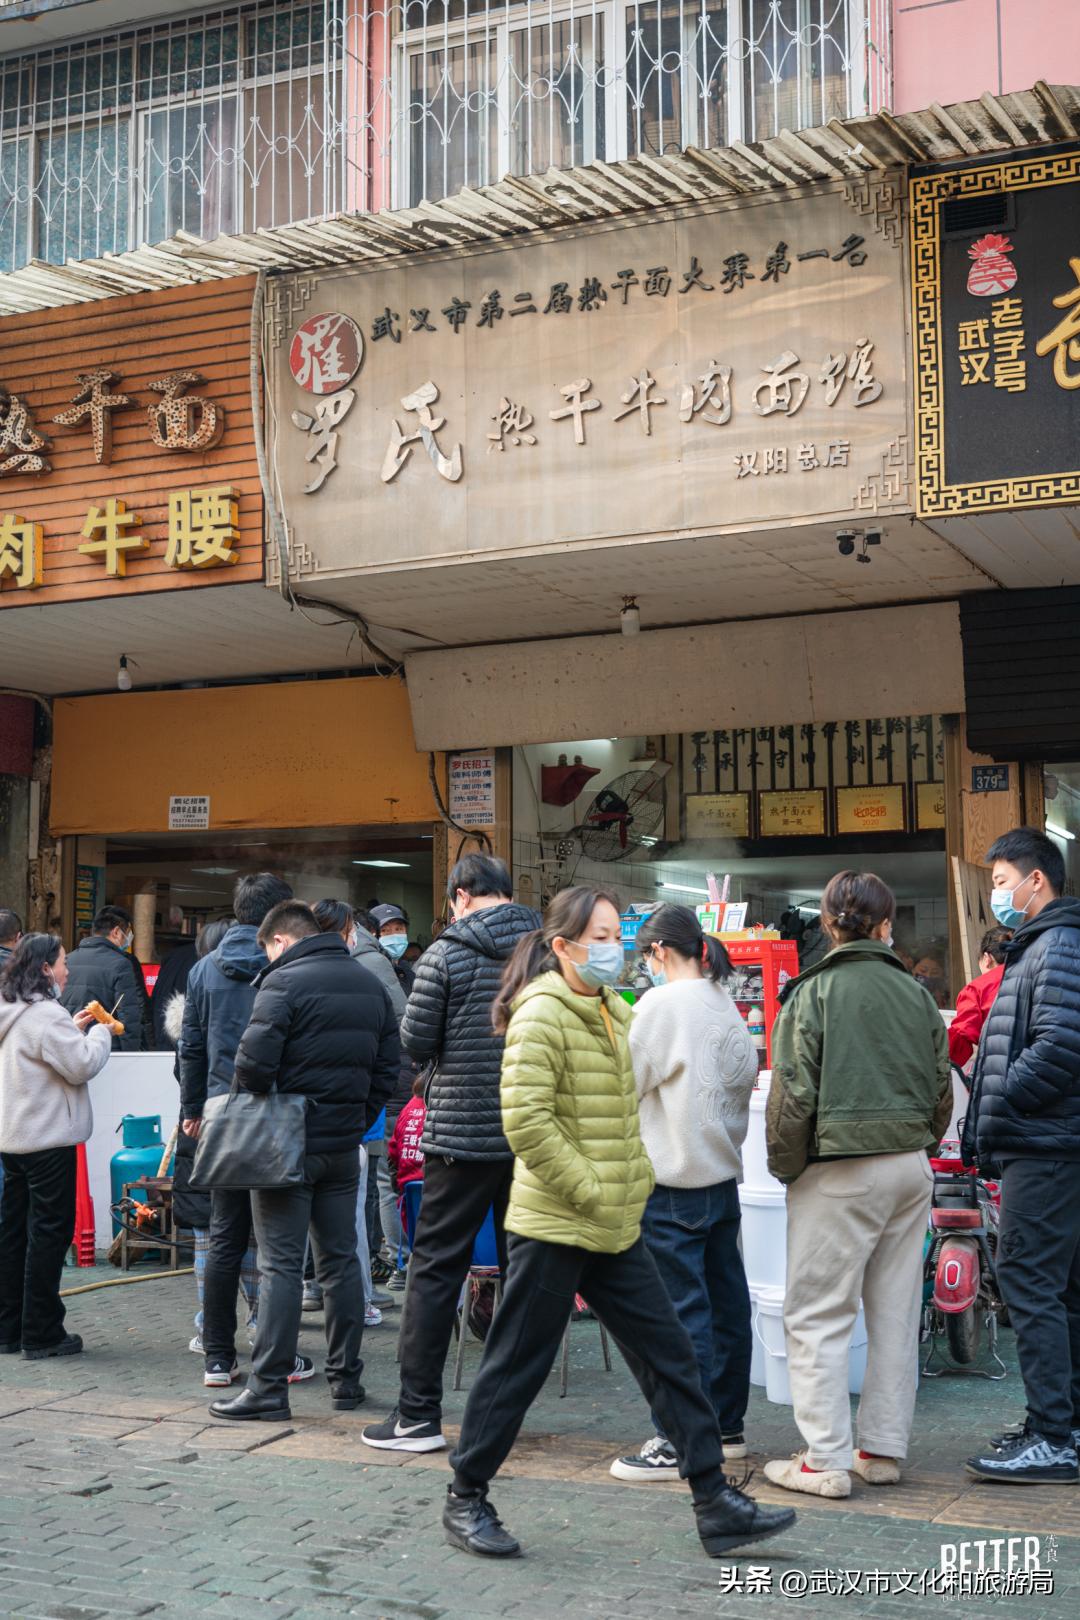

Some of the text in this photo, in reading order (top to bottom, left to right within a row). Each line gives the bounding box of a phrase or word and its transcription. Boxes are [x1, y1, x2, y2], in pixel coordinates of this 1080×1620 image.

[371, 234, 868, 344] 武汉市第二届热干面大赛第一名
[958, 319, 991, 386] 武汉
[991, 298, 1026, 393] 老字号
[733, 440, 850, 478] 汉阳总店
